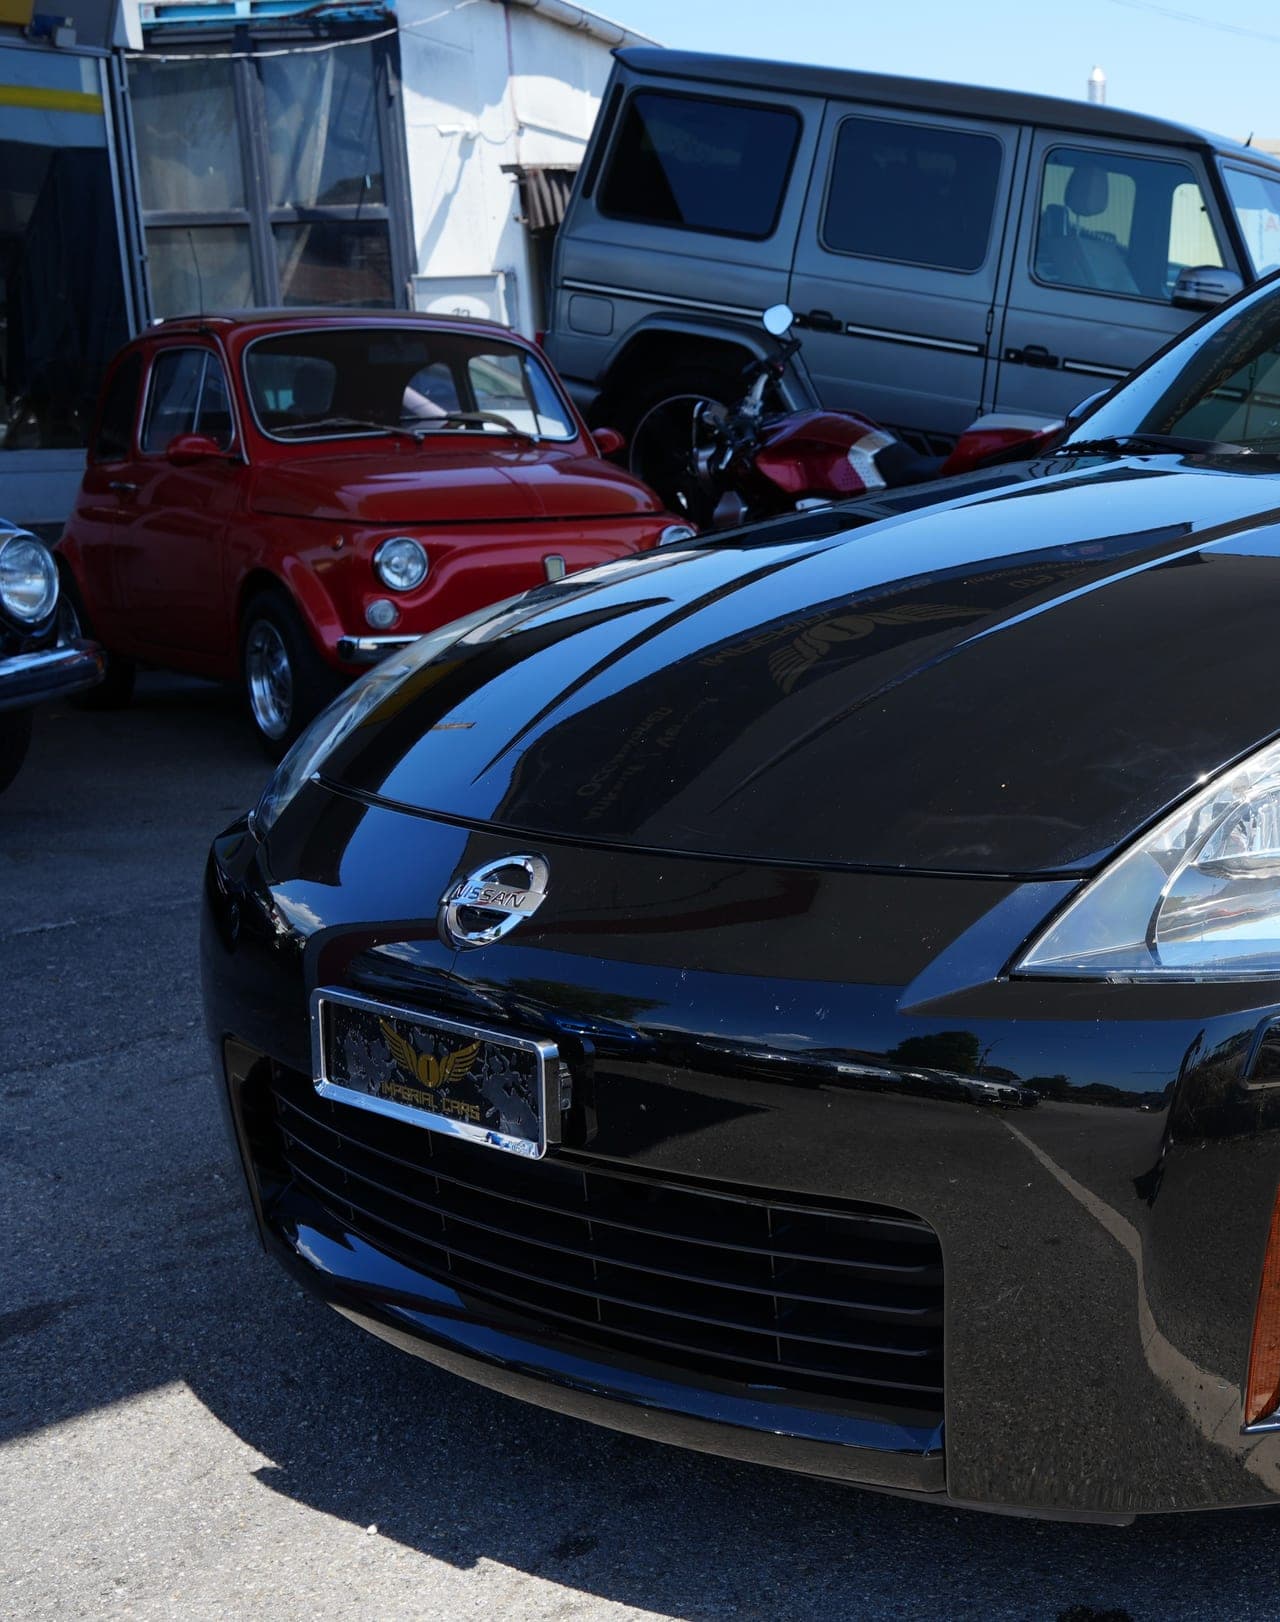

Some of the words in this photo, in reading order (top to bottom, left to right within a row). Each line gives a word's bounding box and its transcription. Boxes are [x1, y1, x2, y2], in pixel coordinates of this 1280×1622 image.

[450, 884, 526, 908] NISSAN
[381, 1080, 438, 1112] IMPERIAL
[443, 1097, 481, 1121] CARS
